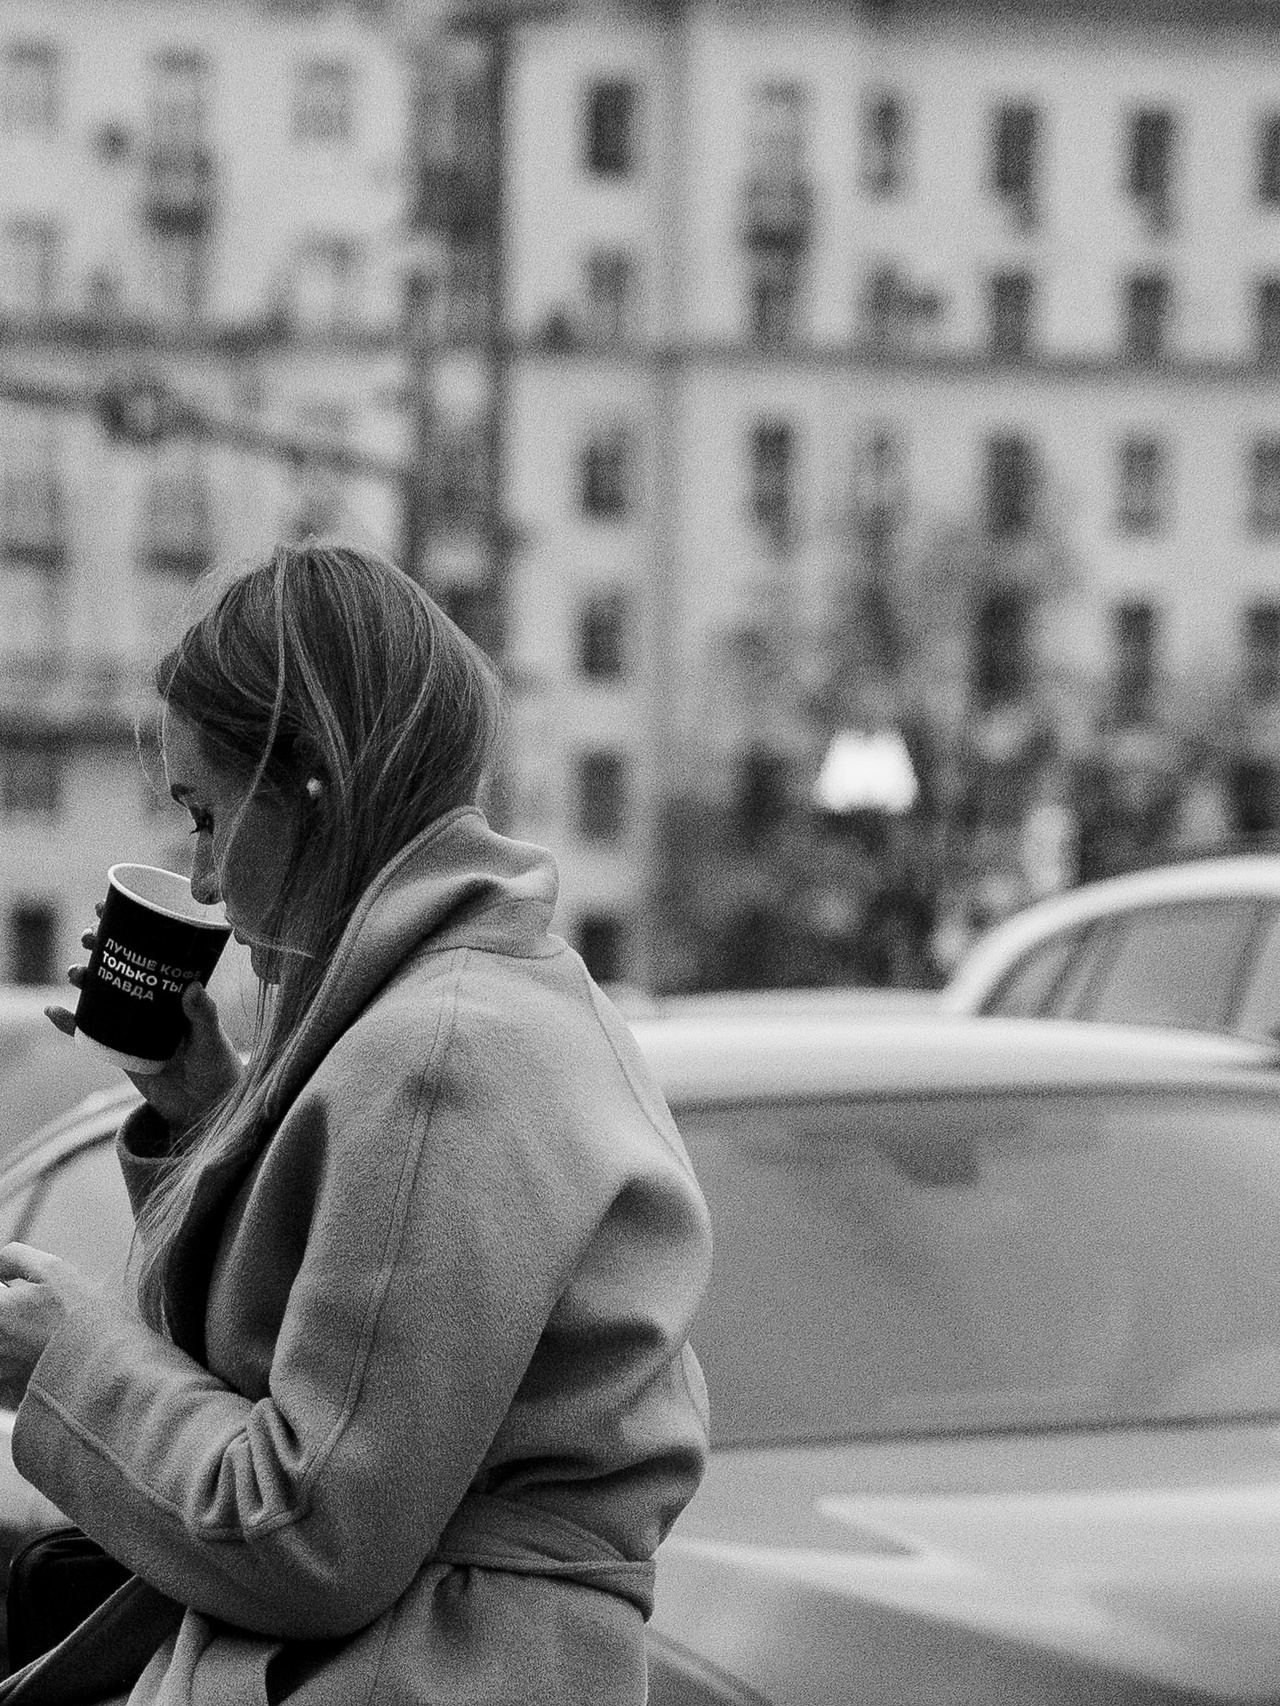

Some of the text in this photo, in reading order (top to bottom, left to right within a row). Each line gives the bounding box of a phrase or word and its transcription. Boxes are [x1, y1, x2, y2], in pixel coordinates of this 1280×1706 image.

[102, 950, 158, 987] ТОЛЬКО
[105, 937, 158, 972] ЛУЧШЕ
[97, 966, 155, 1002] ПРАВДА
